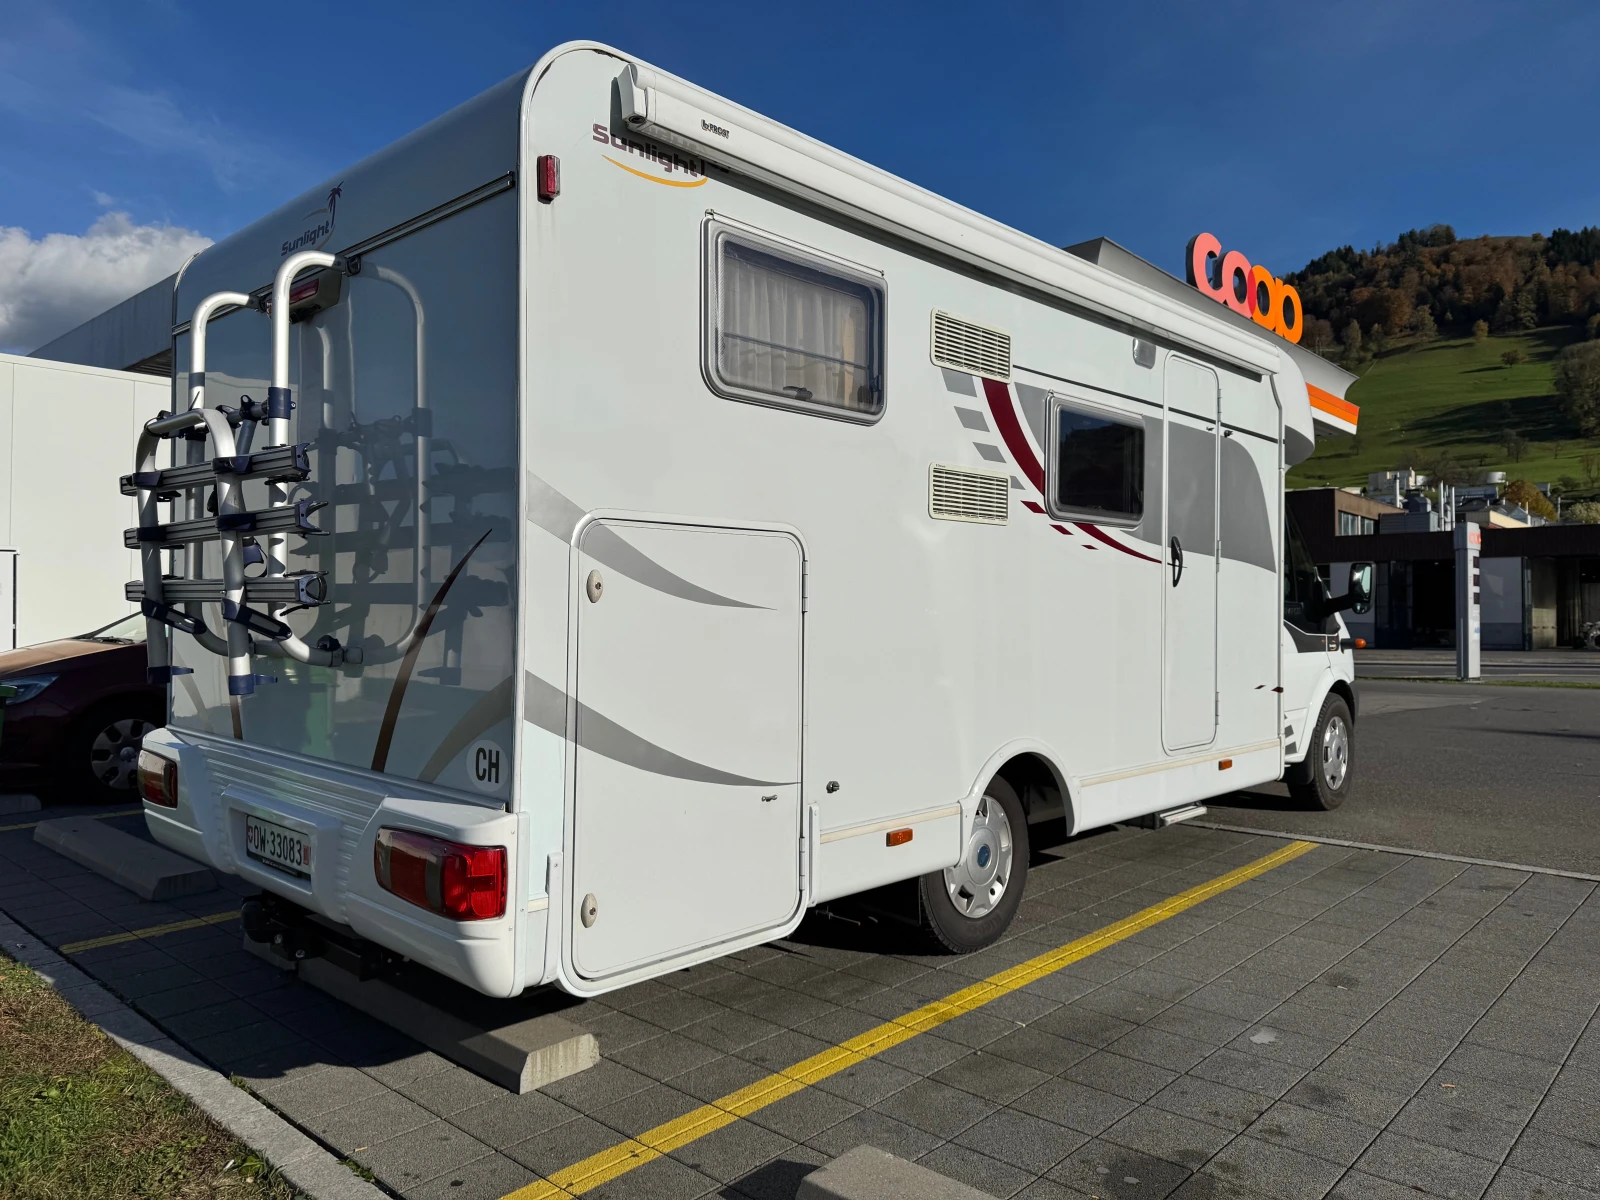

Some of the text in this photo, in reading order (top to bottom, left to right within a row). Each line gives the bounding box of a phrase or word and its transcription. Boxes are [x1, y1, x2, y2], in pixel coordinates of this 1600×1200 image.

[592, 123, 698, 178] Sunlight
[281, 220, 330, 256] Sunlight
[475, 746, 500, 784] CH
